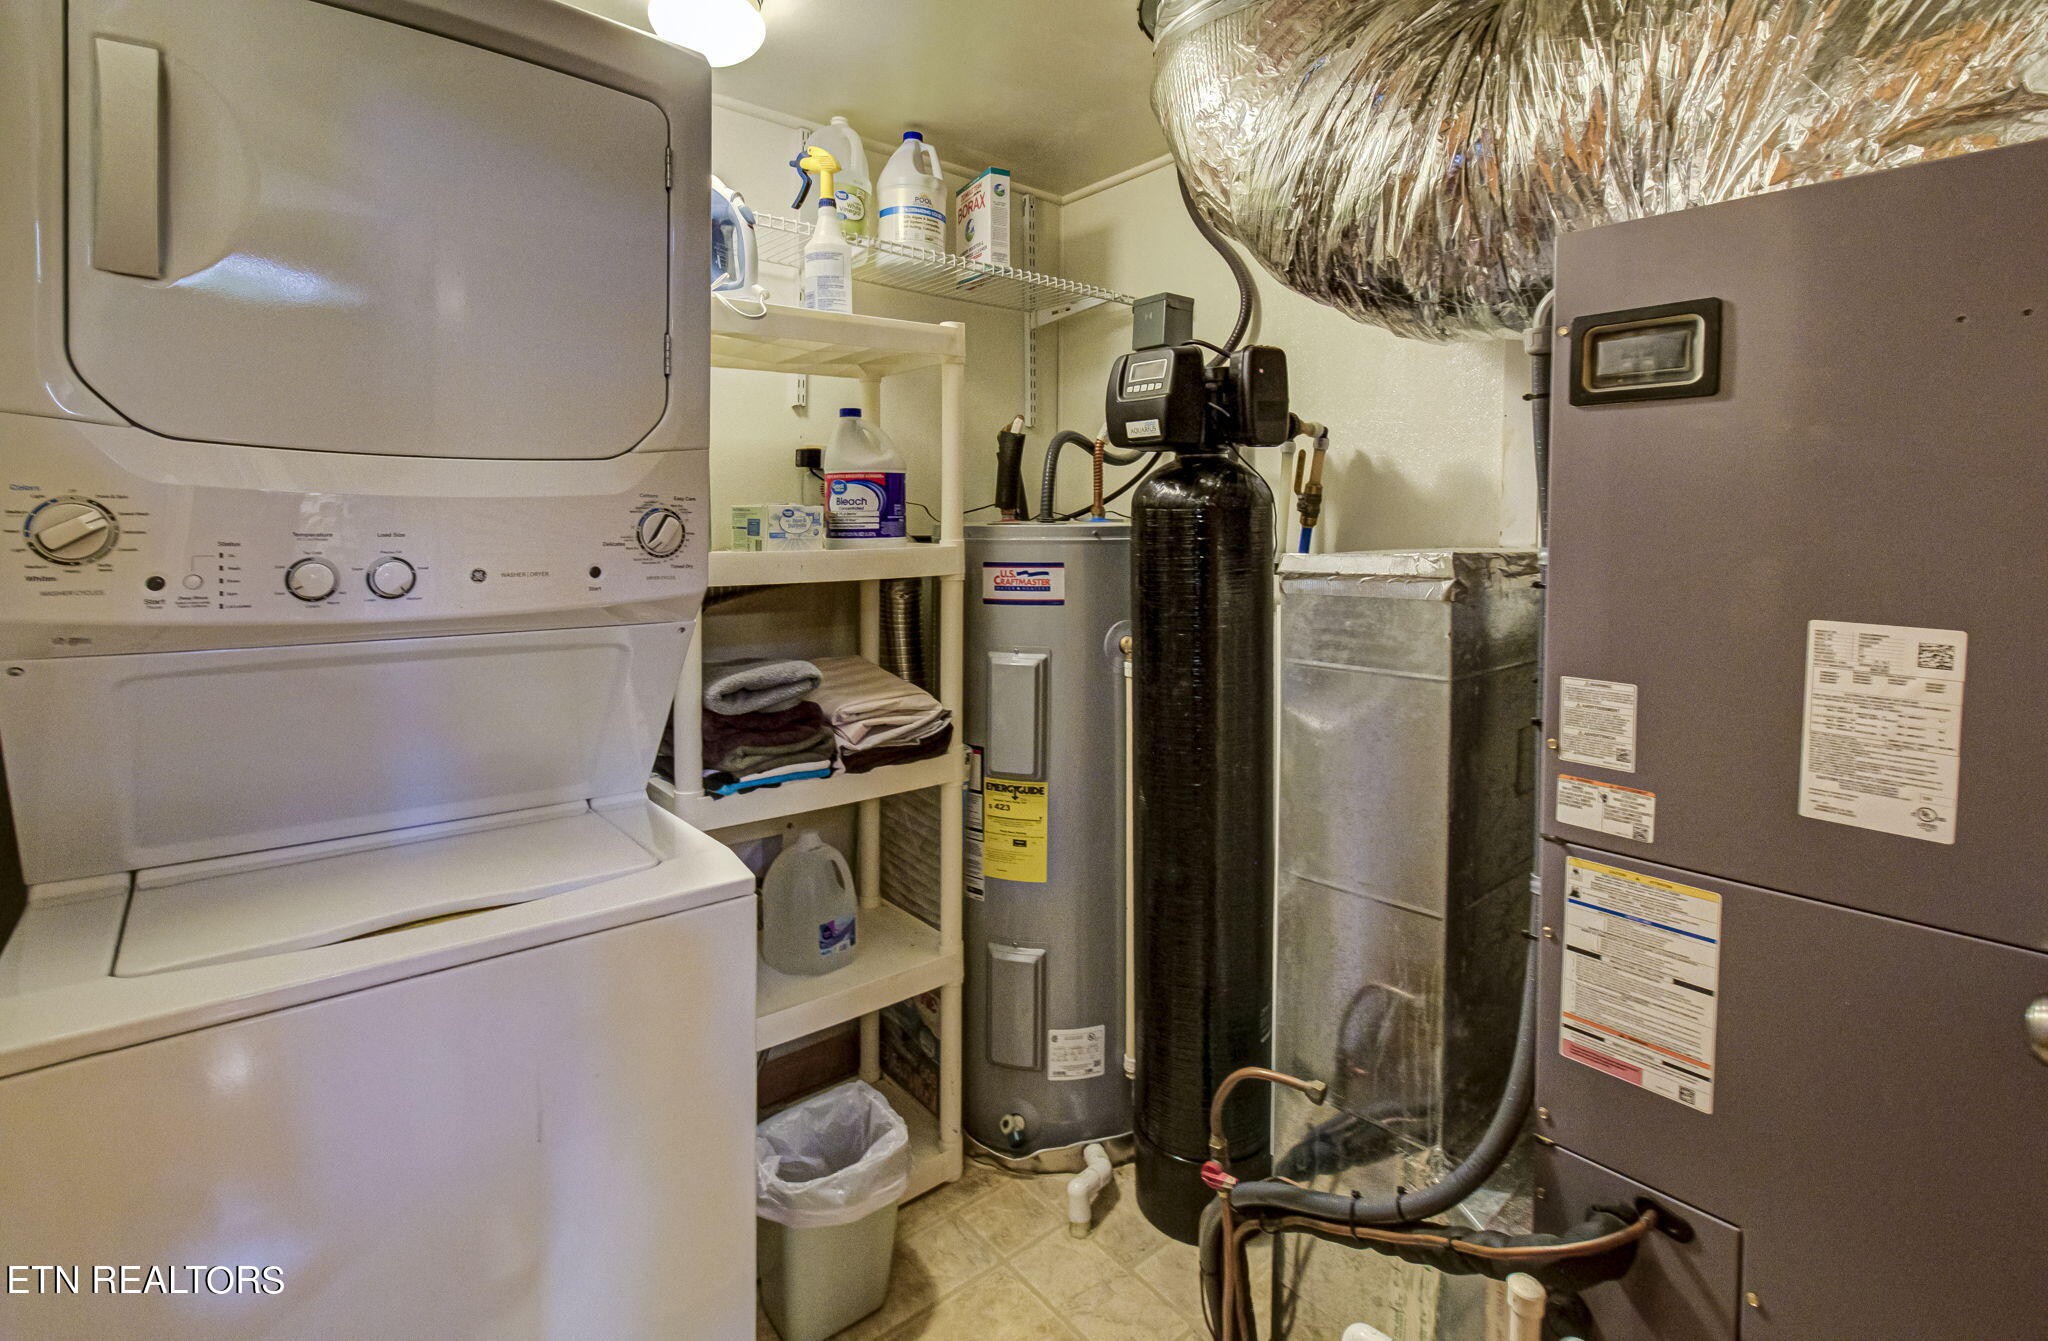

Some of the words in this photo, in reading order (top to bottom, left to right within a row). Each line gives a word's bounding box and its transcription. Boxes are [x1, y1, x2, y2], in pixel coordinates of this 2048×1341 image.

[914, 196, 932, 205] POOL
[958, 192, 986, 225] BORAX
[836, 497, 868, 506] Bleach
[1000, 569, 1016, 578] U.S.
[993, 576, 1051, 586] CRAFTMASTER
[994, 803, 1011, 811] 423
